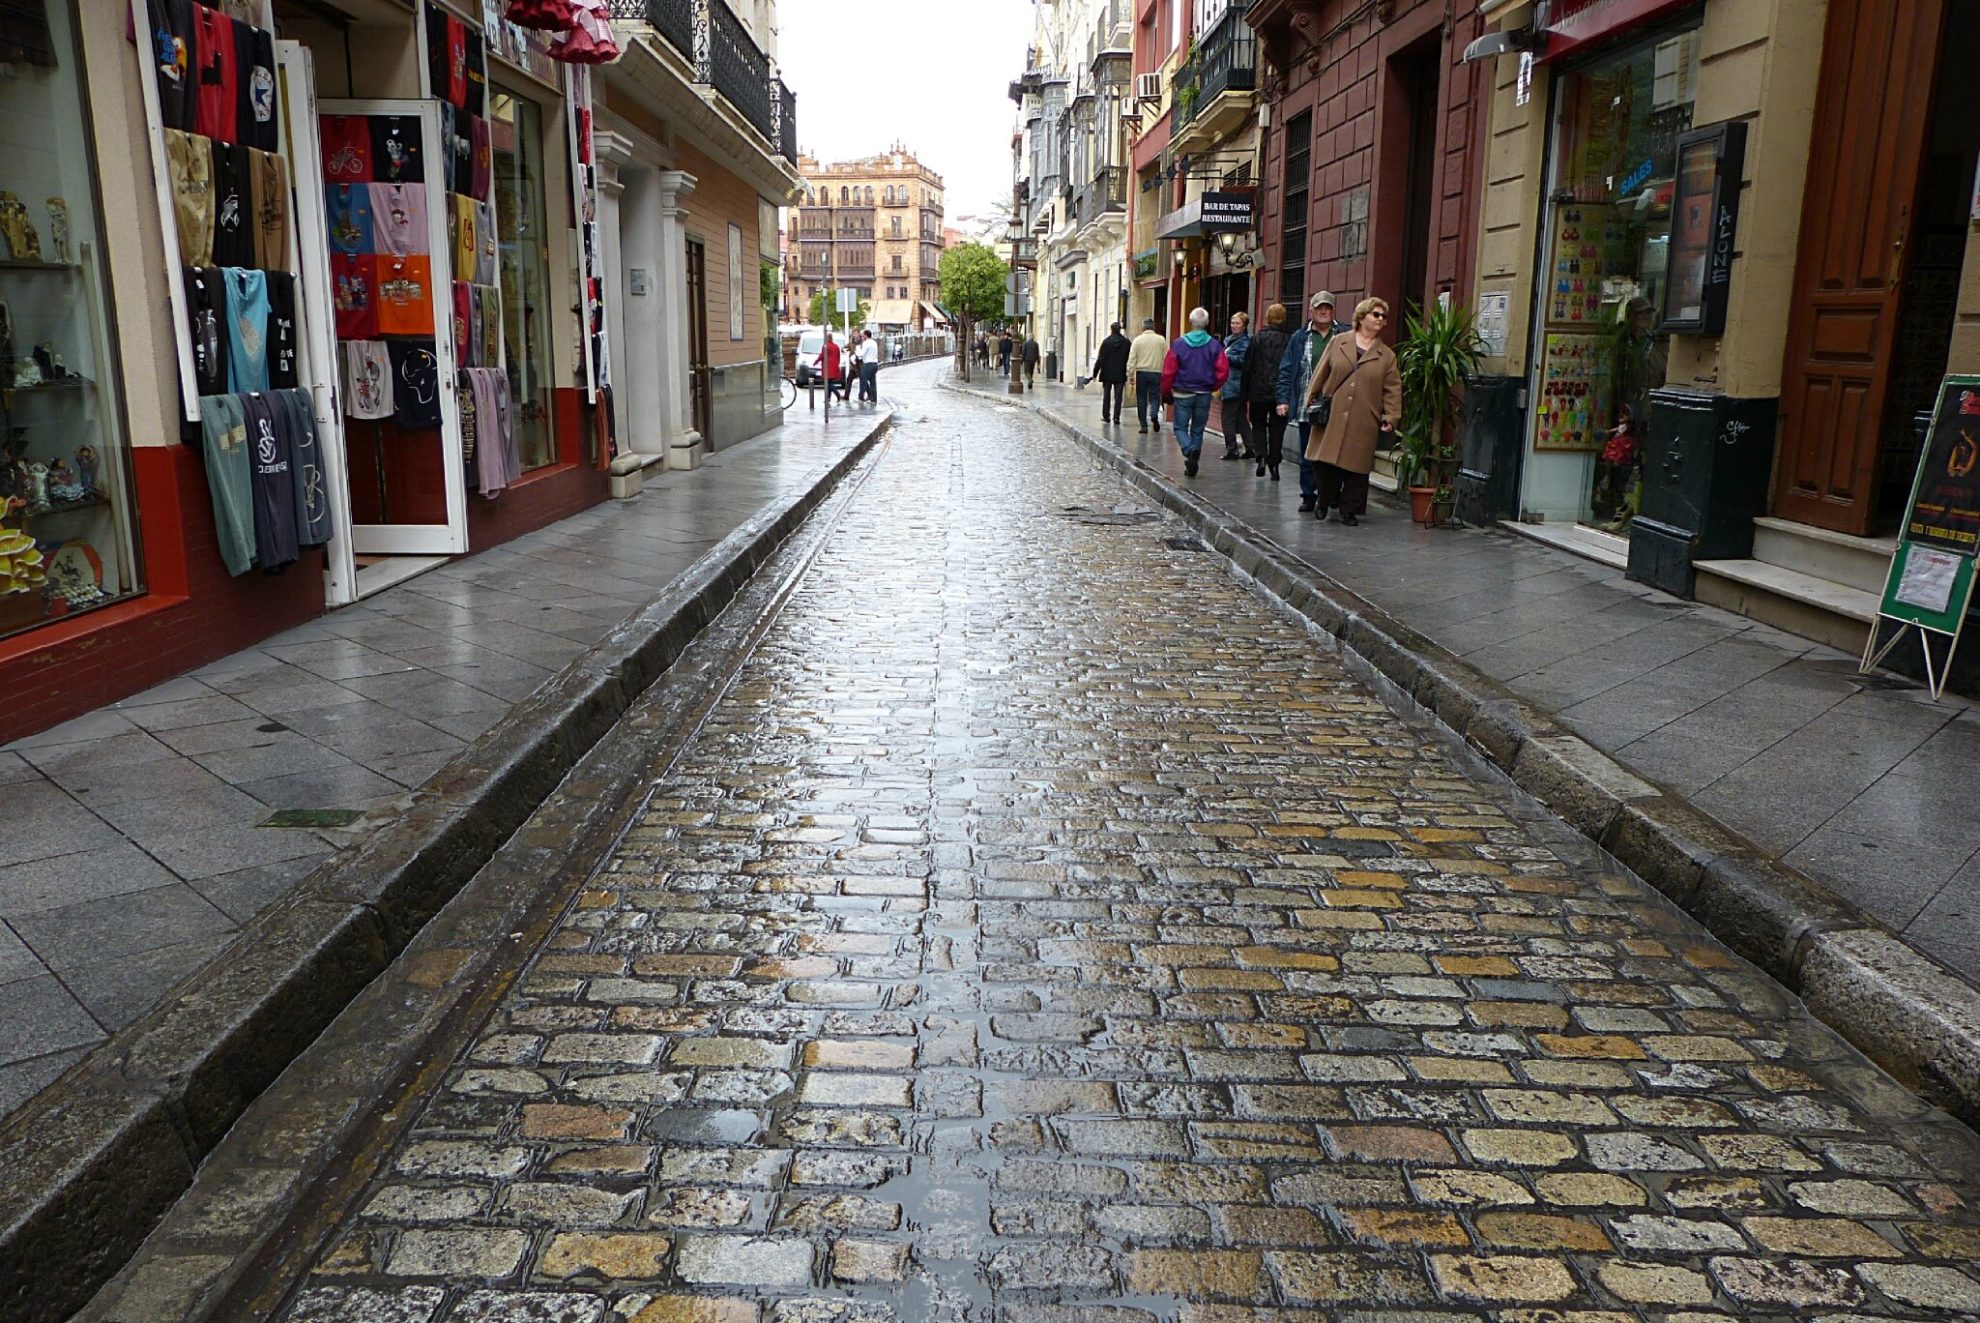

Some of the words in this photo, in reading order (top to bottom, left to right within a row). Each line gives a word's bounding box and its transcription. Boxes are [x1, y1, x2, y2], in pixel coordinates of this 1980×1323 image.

[1620, 157, 1654, 196] SALES
[1219, 203, 1229, 211] DE
[1230, 203, 1250, 211] TAPAS
[1202, 215, 1250, 223] RESTAURANTE
